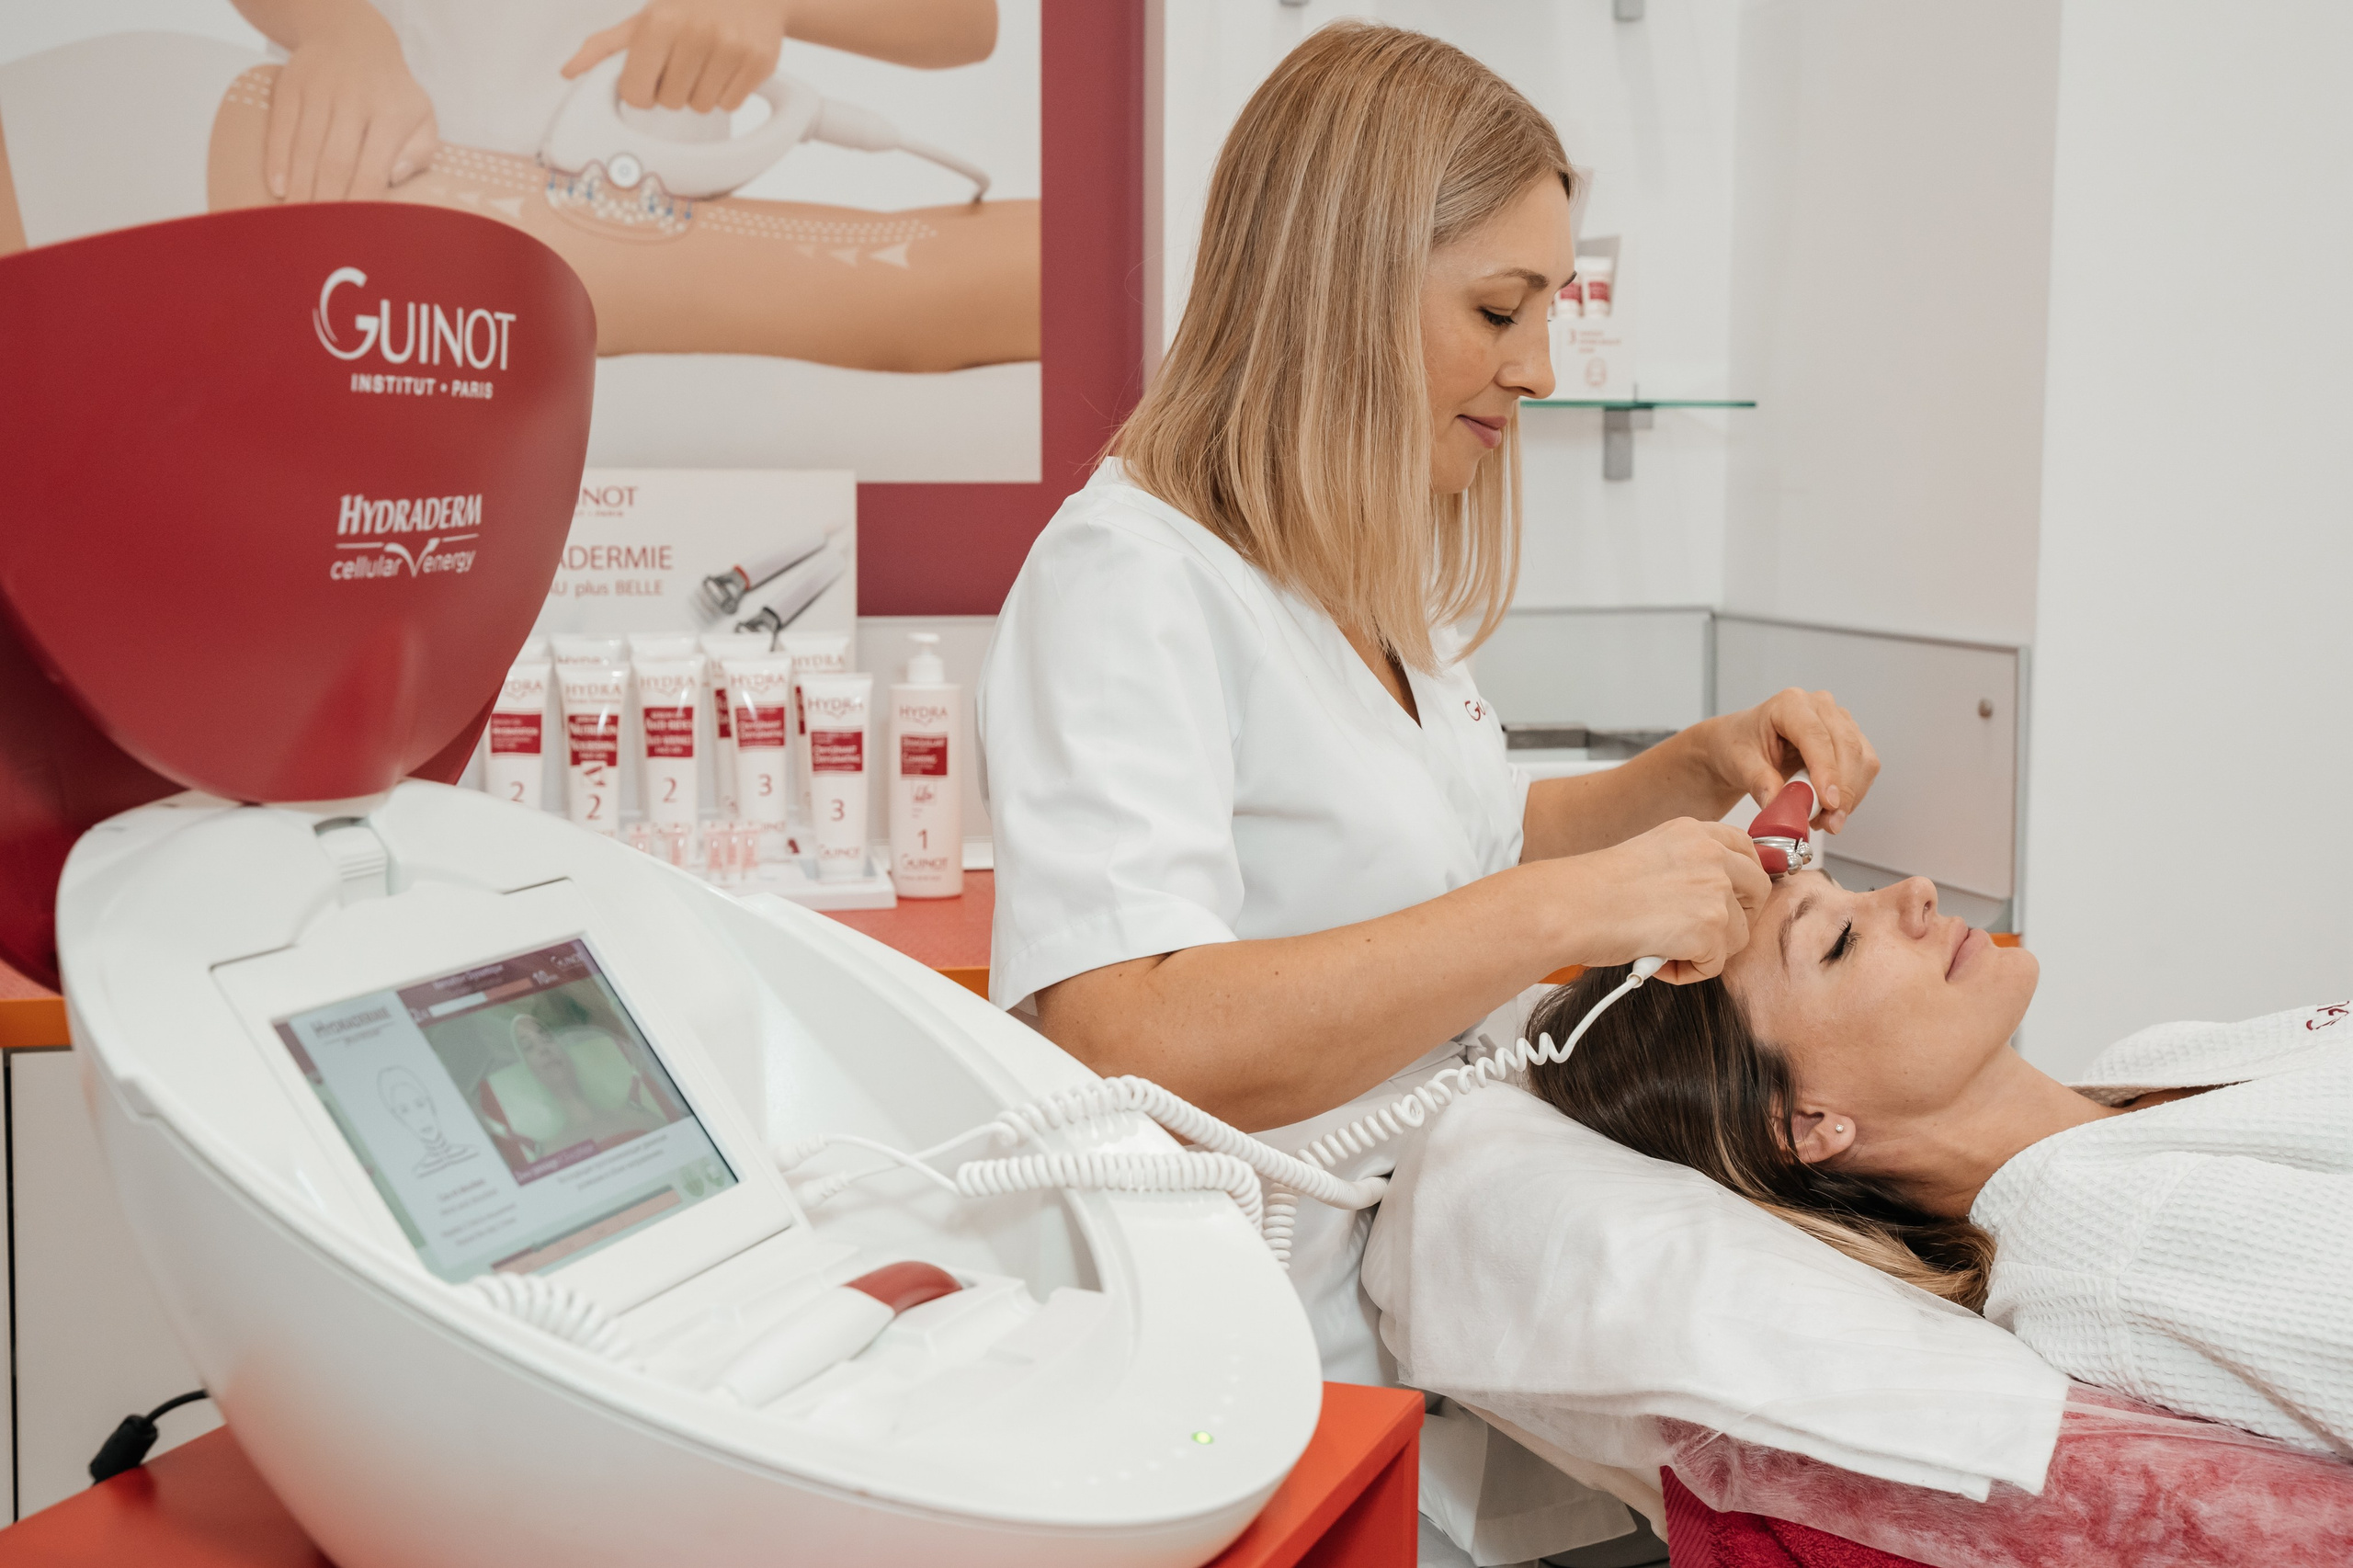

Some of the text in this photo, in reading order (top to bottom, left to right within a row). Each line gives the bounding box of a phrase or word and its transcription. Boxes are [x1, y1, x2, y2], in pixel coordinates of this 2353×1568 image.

[313, 267, 517, 370] GUINOT
[350, 373, 494, 400] INSTITUT PARIS
[576, 484, 638, 507] NOT
[336, 493, 483, 536] HYDRADERM
[330, 550, 477, 581] cellular energy
[574, 579, 608, 599] plus
[615, 579, 664, 597] BELLE
[565, 683, 622, 697] HYDRA
[640, 674, 697, 688] HYDRA
[730, 672, 786, 687] HYDRA
[807, 696, 864, 711] HYDRA
[899, 704, 948, 719] HYDRA
[509, 780, 526, 803] 2
[662, 777, 677, 803] 2
[757, 773, 773, 797] 3
[585, 793, 603, 821] 2
[829, 798, 846, 822] 3
[917, 828, 929, 851] 1
